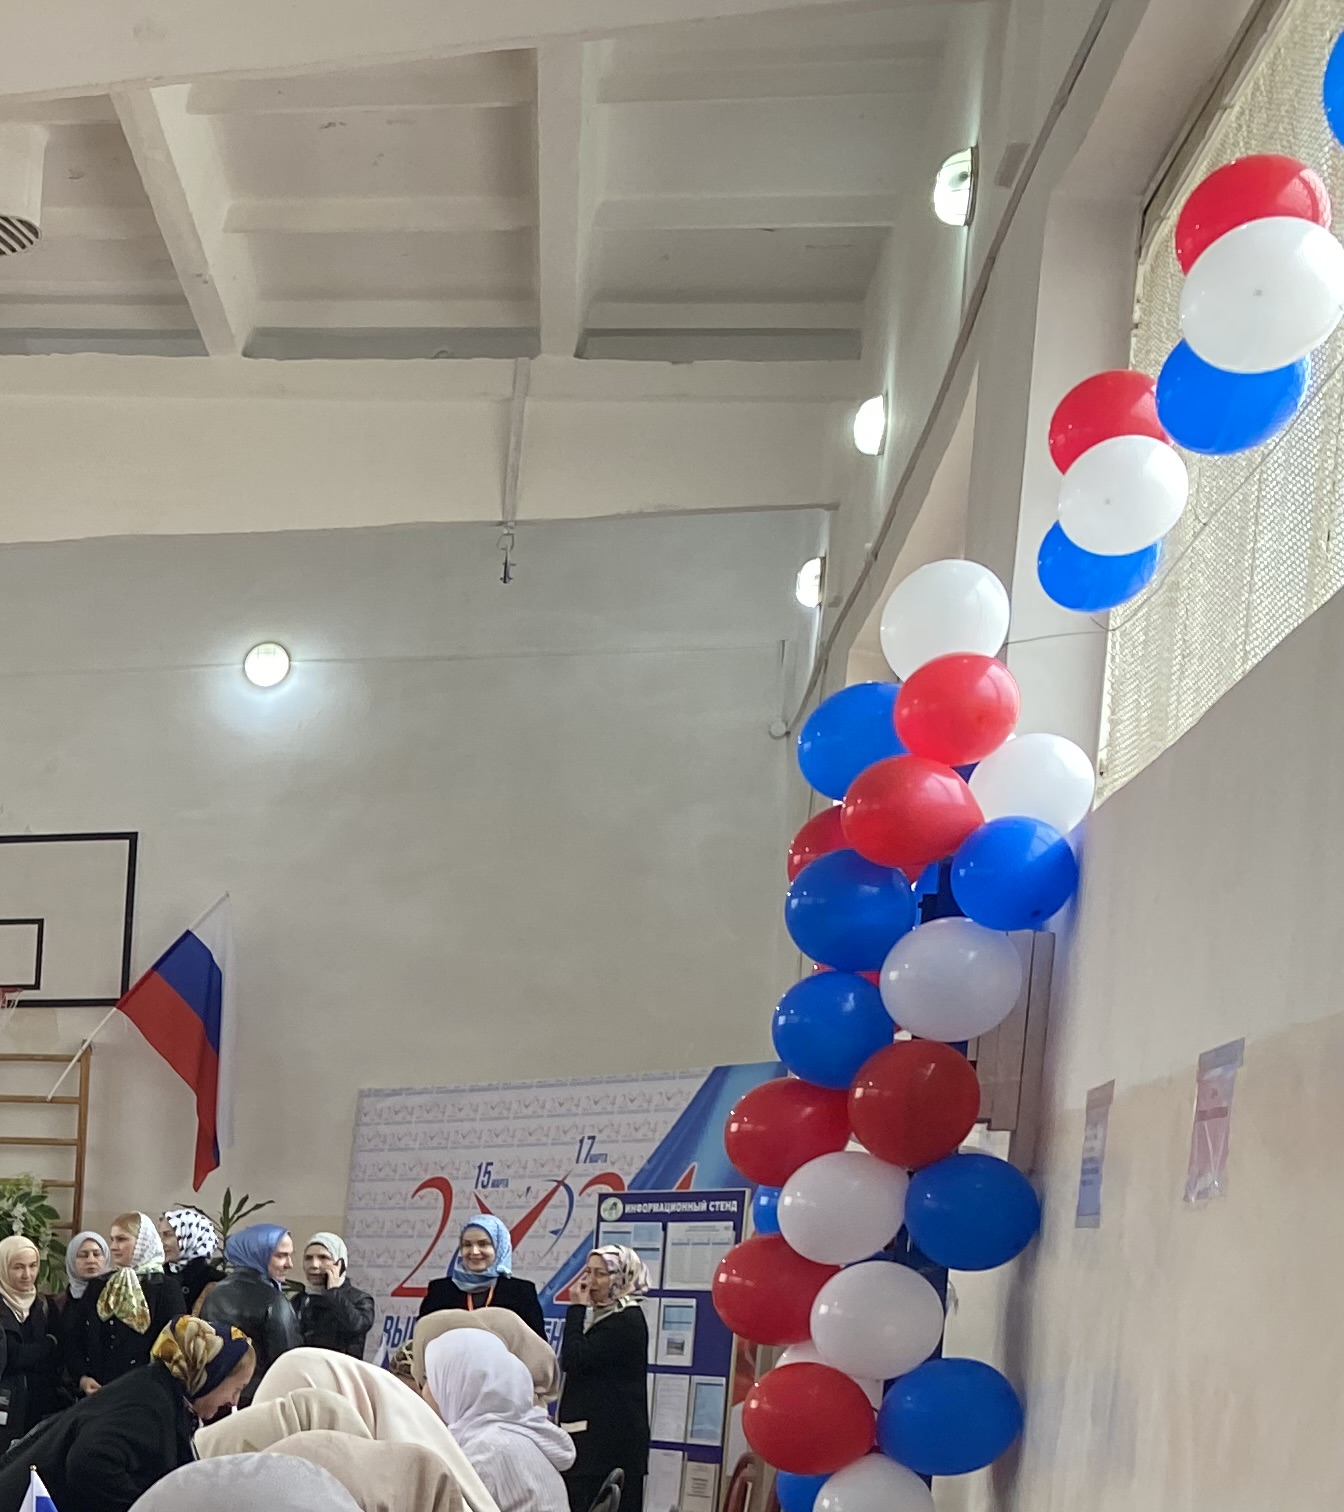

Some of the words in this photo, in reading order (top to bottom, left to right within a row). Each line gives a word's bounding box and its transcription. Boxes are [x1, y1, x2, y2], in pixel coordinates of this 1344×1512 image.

[575, 1134, 598, 1165] 17
[474, 1160, 494, 1190] 15
[624, 1199, 708, 1215] ИНФОРМАЦИОННЫЙ
[708, 1199, 739, 1214] СТЕНД
